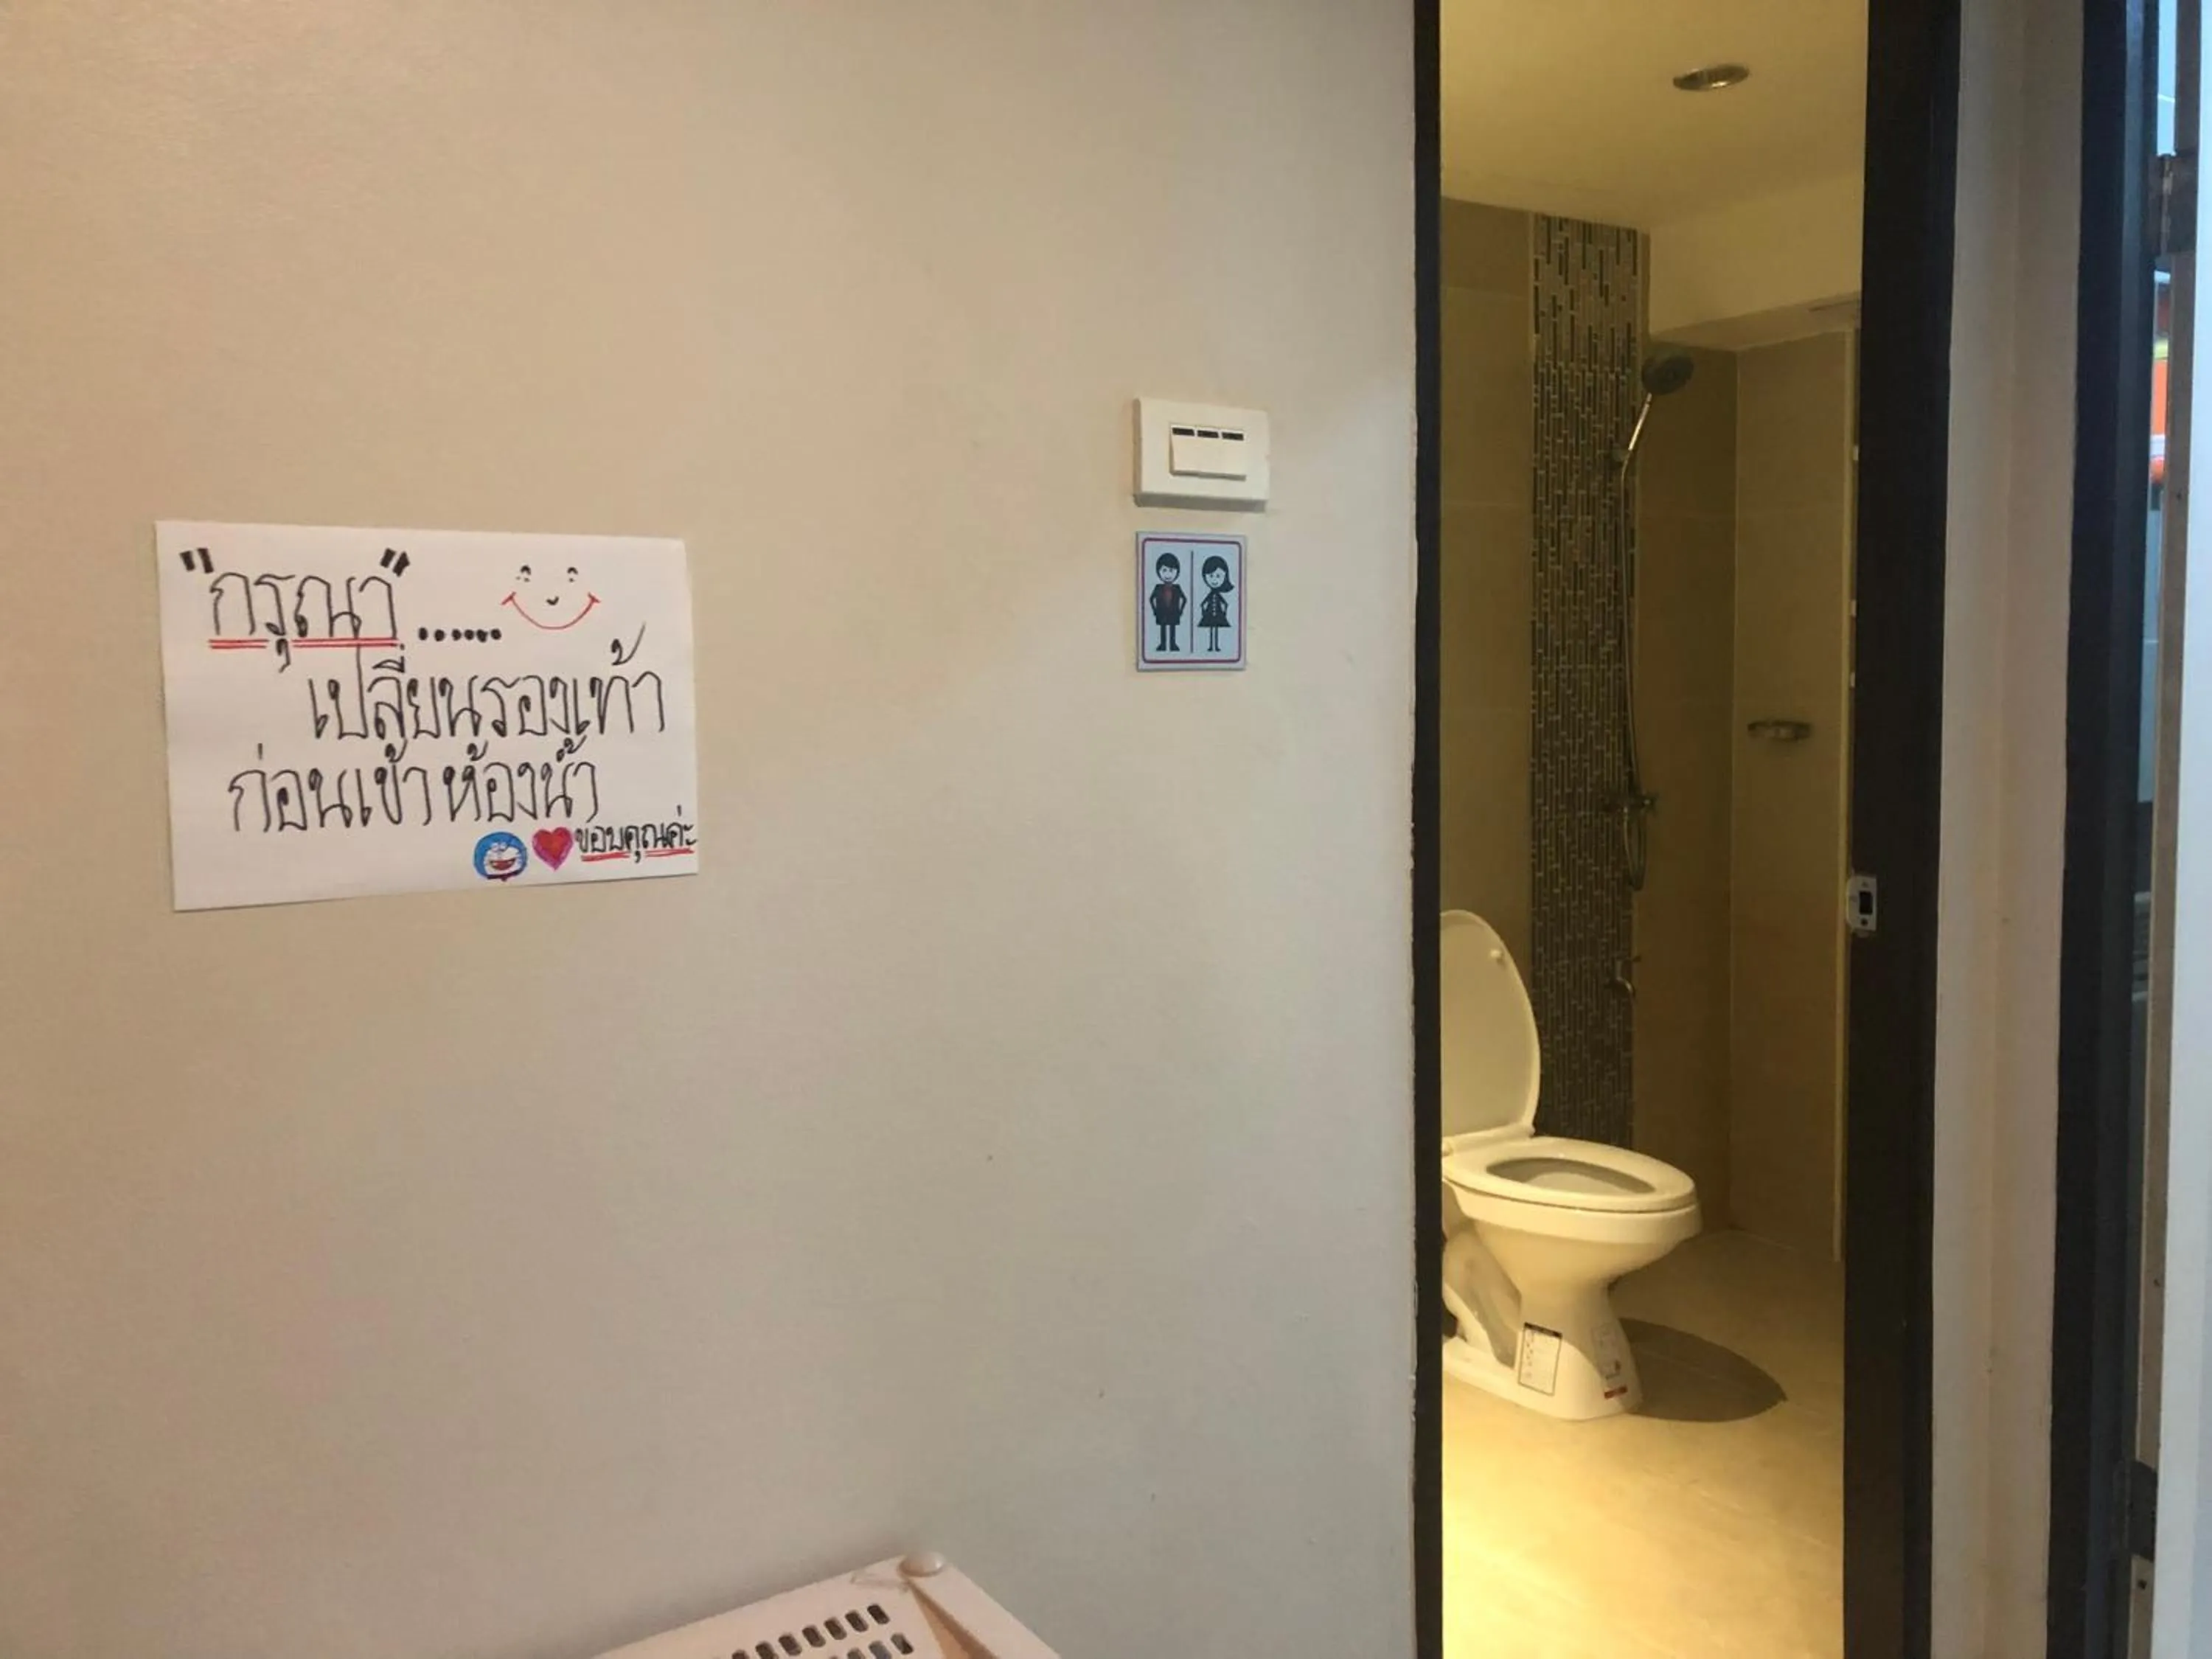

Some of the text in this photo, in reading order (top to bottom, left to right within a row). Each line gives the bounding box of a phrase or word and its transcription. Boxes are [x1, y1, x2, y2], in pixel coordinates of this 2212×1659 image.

[307, 623, 666, 740] เปลี่ยนรองเท้า
[574, 804, 698, 863] ขอบคุณค่ะ
